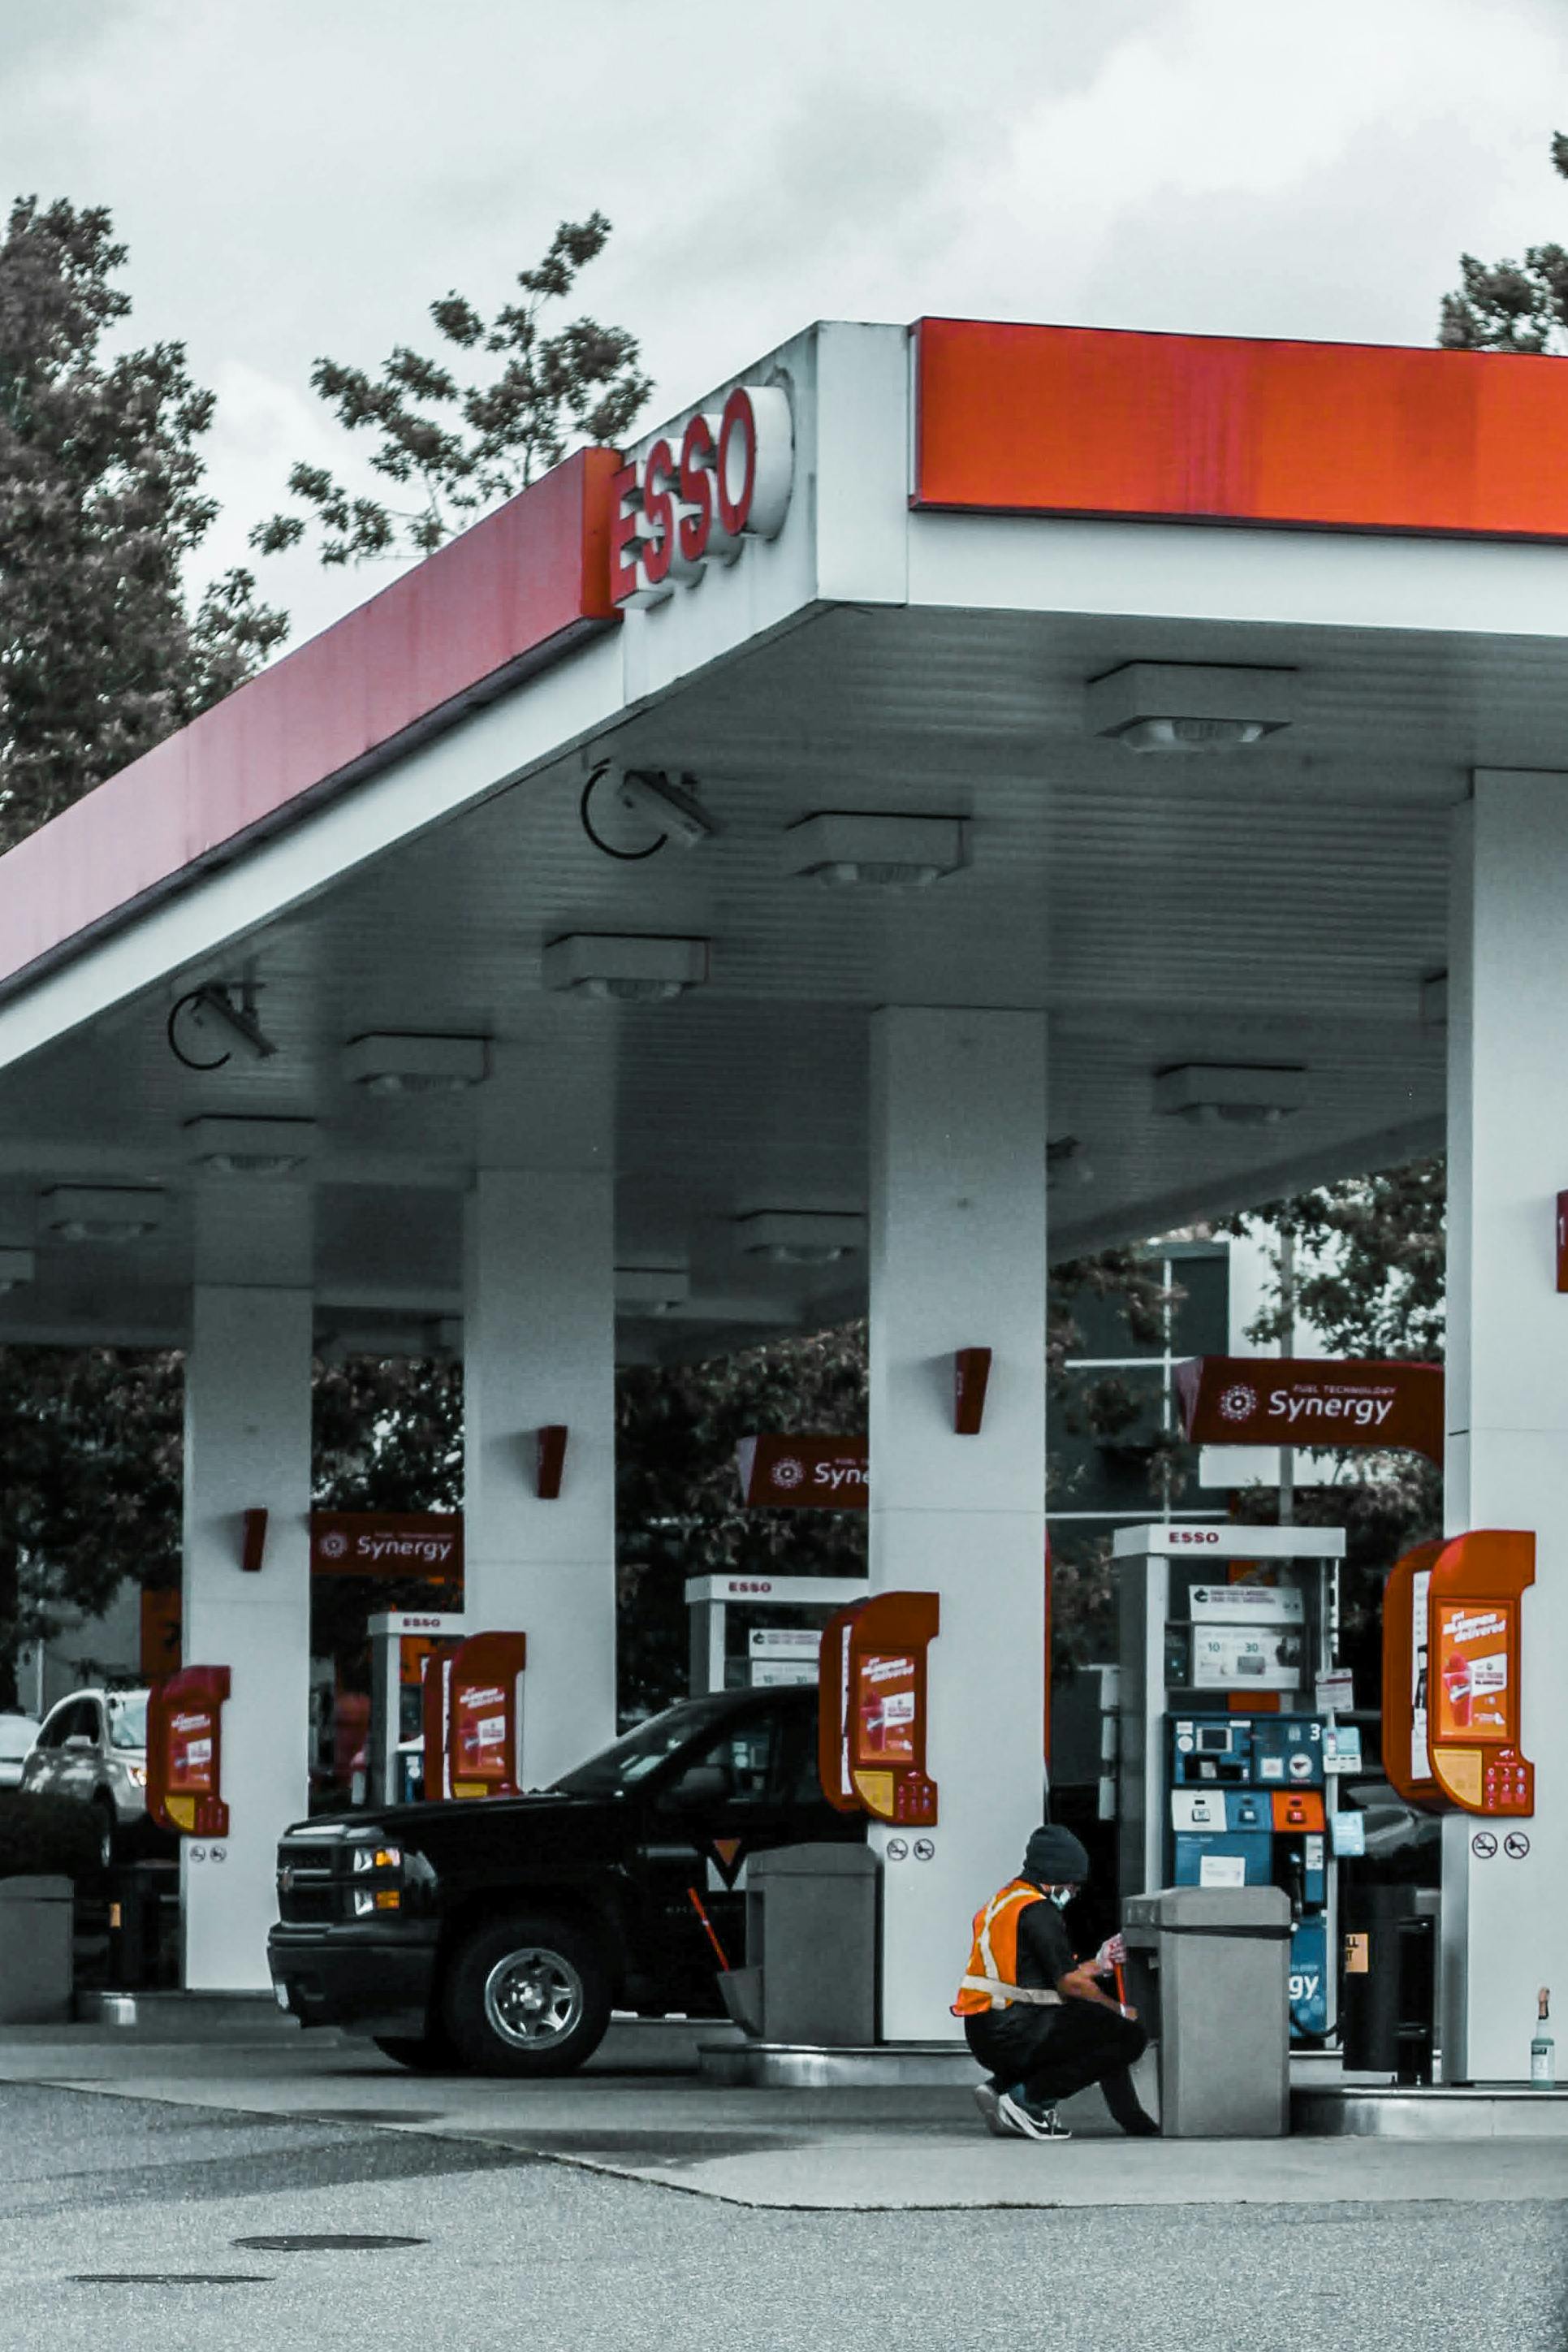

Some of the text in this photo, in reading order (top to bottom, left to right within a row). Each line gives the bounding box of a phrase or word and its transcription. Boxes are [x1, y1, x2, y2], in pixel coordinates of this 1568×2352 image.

[610, 387, 756, 607] ESSO
[1268, 1390, 1393, 1425] Synergy
[357, 1535, 451, 1562] Synergy
[1168, 1532, 1219, 1544] ESSO
[728, 1581, 771, 1593] ESSO
[1310, 1723, 1321, 1741] 3
